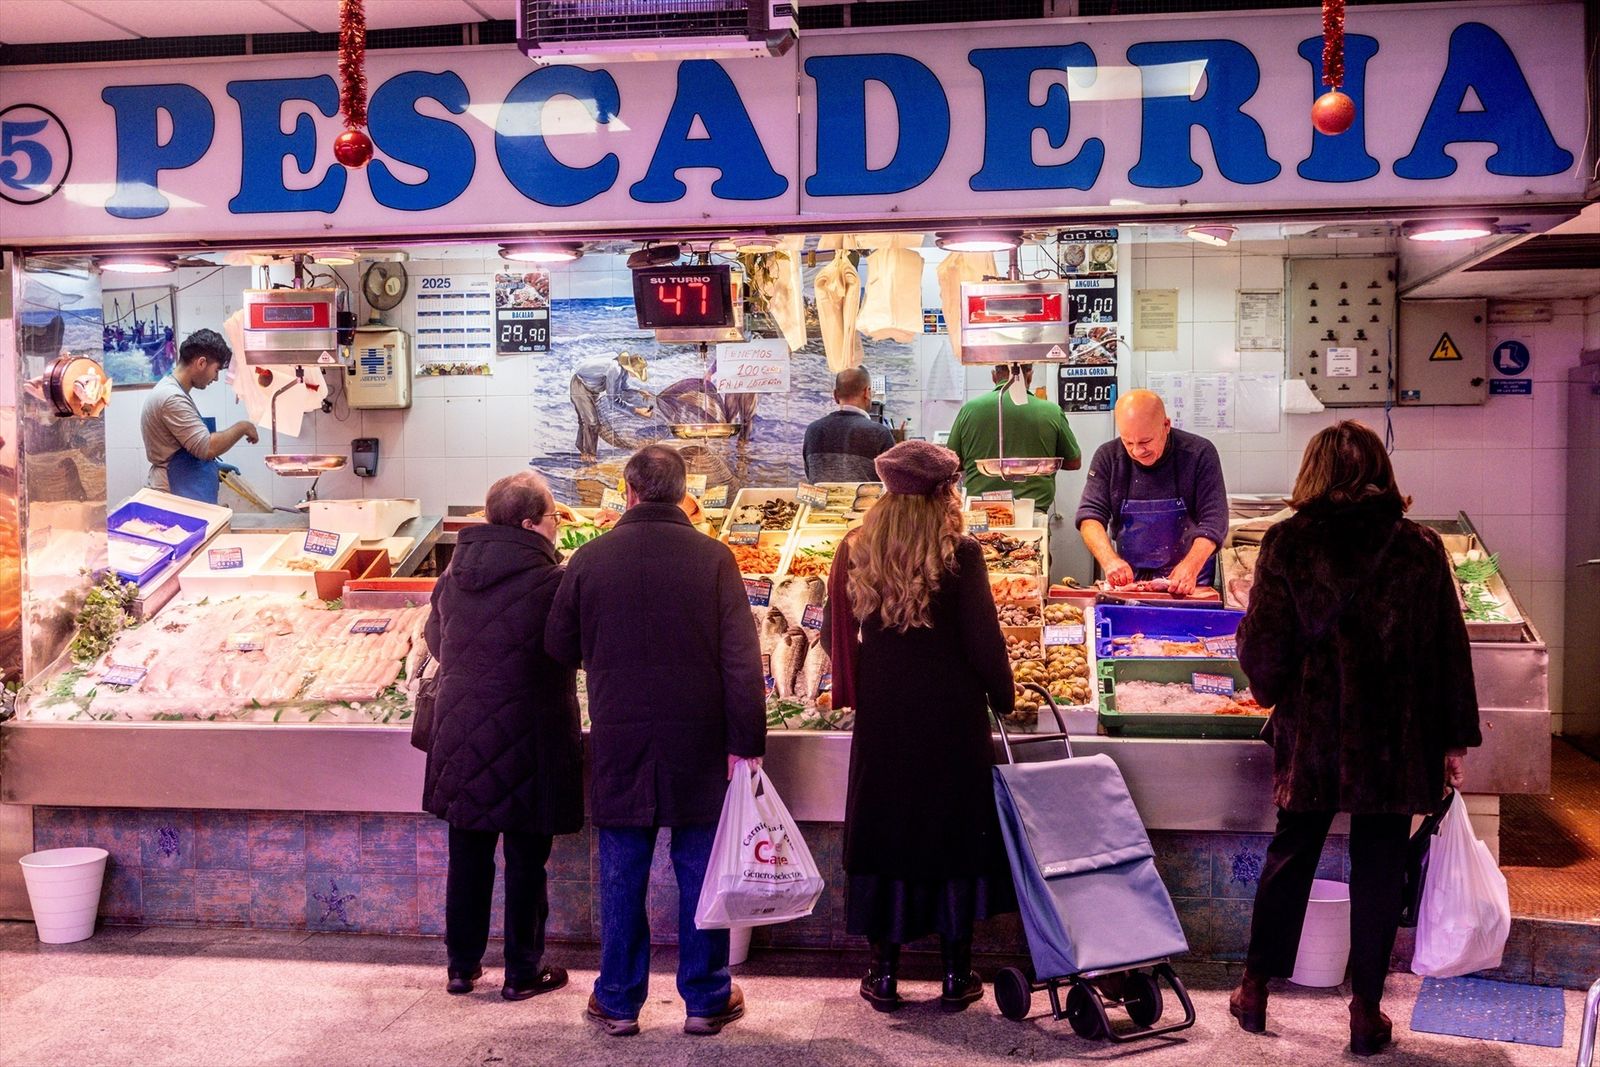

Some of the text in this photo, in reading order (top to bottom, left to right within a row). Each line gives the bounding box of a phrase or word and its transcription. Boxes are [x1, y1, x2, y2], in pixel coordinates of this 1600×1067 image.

[101, 21, 1575, 219] PESCADERIA
[0, 118, 53, 190] 5
[421, 278, 451, 289] 2025
[669, 276, 711, 284] TURNO
[1075, 280, 1100, 288] ANGULAS
[658, 282, 707, 316] 47
[511, 311, 534, 319] BACALAO
[501, 324, 546, 344] 29,90
[1067, 368, 1108, 376] GAMBA GORDA
